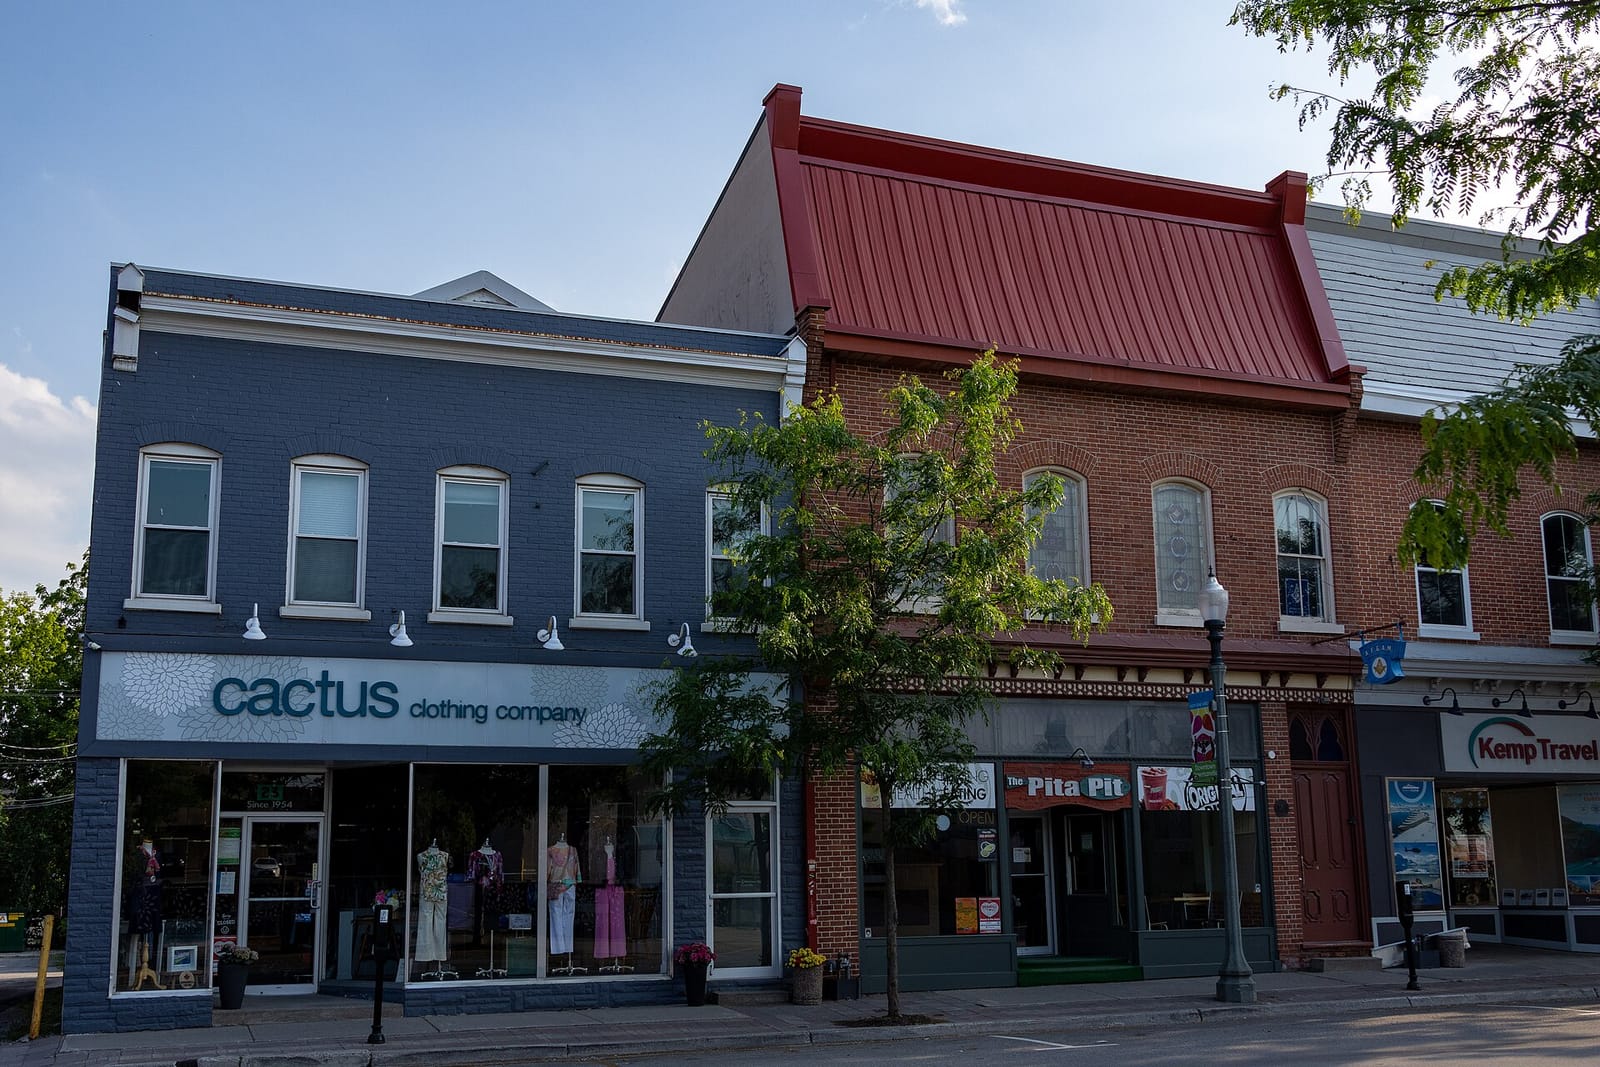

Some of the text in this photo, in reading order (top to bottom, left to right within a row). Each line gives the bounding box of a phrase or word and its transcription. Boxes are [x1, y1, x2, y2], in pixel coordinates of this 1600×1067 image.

[213, 670, 587, 726] cactus clothing company
[1478, 737, 1599, 765] Kemp Travel
[1008, 776, 1125, 797] The Pita Pit
[247, 800, 293, 809] Since 1954
[959, 810, 995, 825] OPEN
